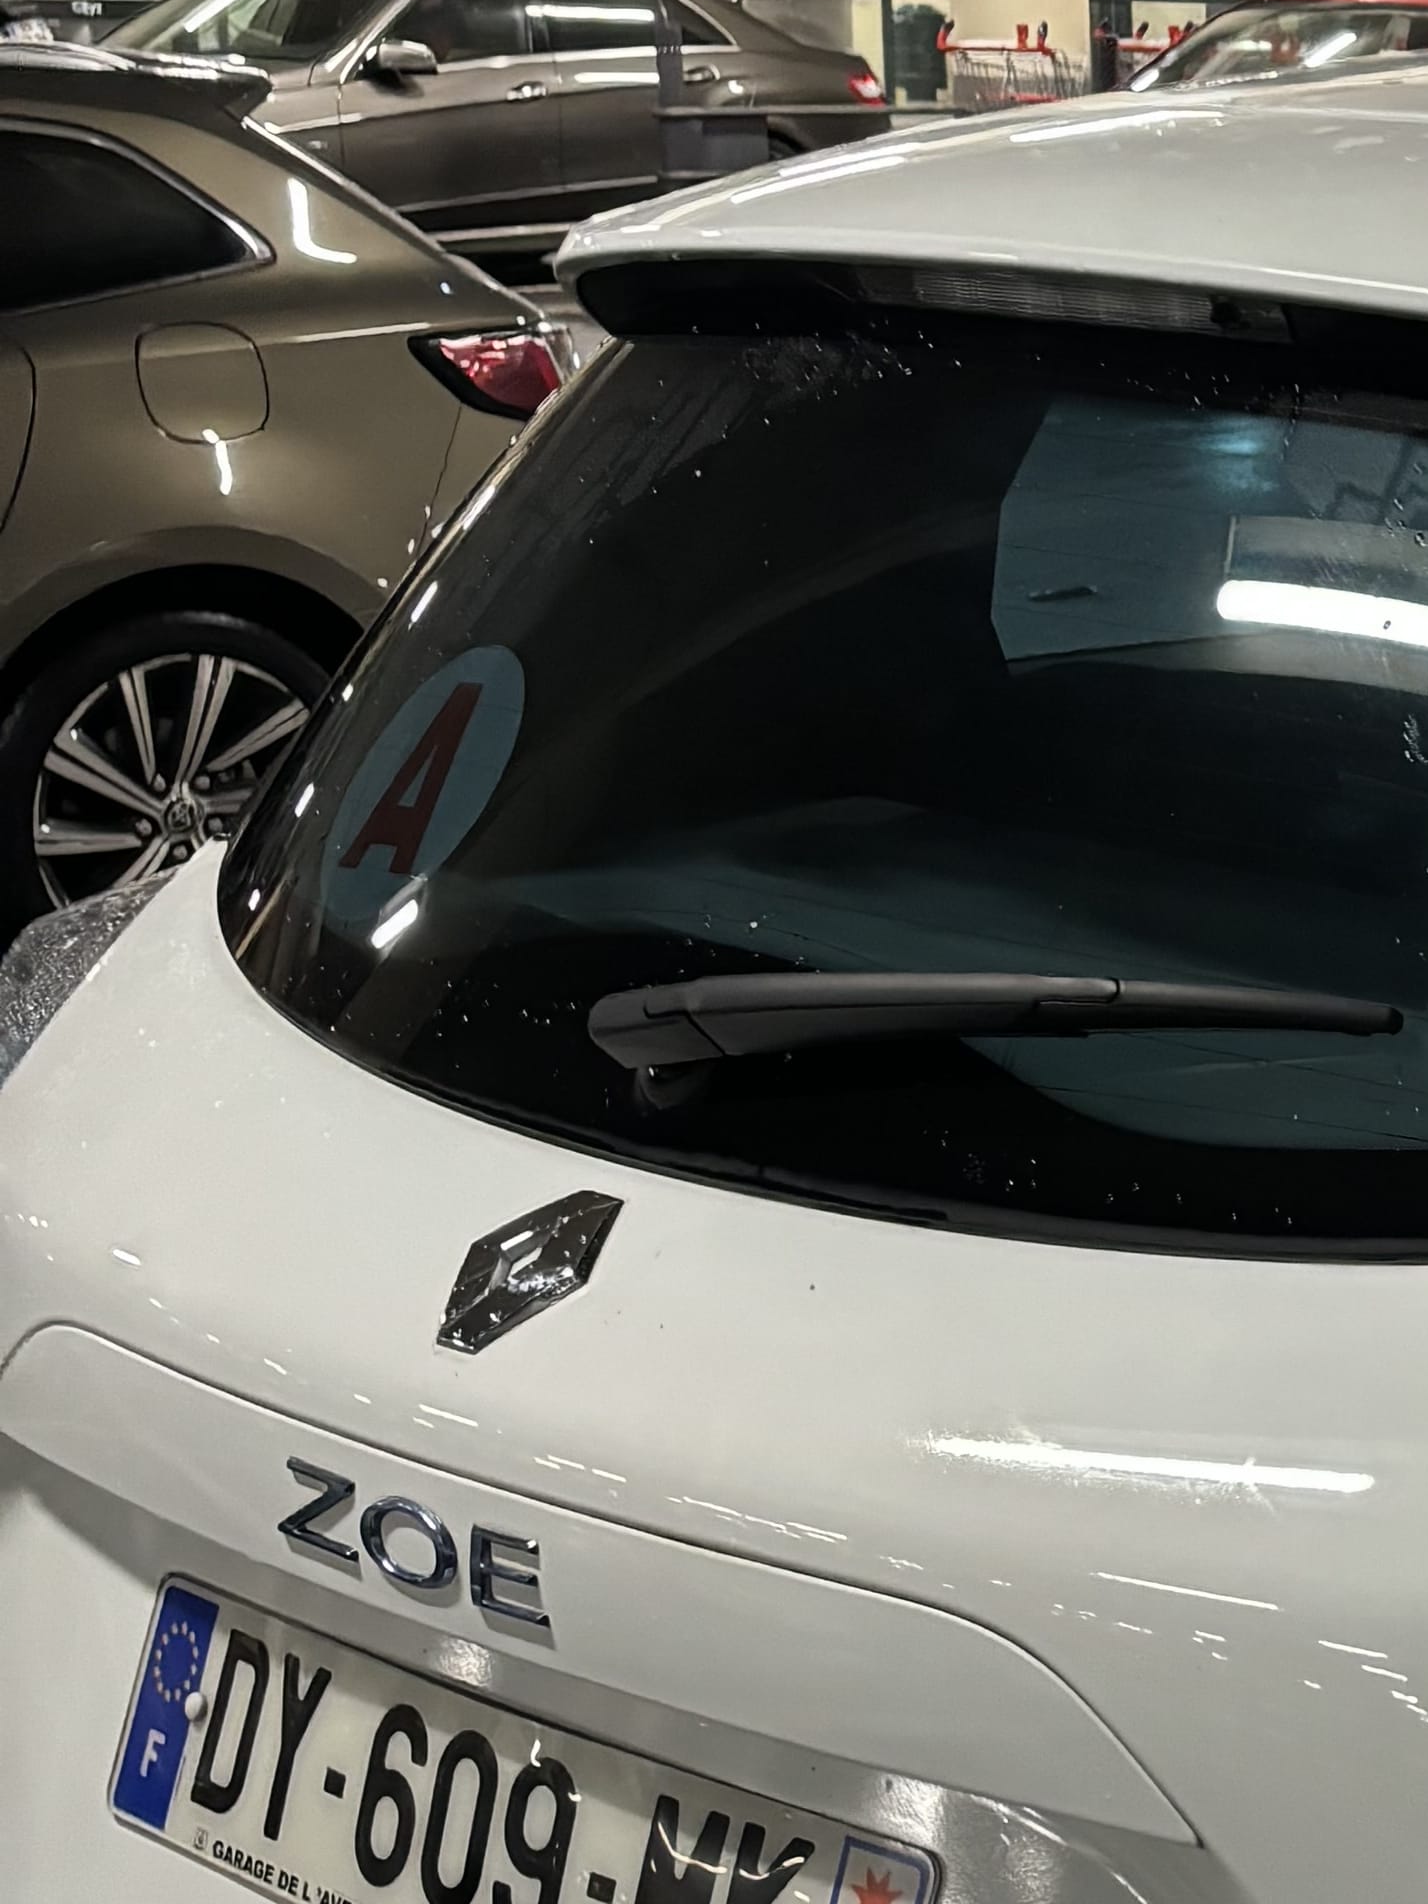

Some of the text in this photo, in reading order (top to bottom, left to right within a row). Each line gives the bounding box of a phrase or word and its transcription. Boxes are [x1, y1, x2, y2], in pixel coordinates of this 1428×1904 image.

[338, 682, 484, 874] A
[278, 1456, 552, 1627] ZOE
[140, 1729, 166, 1777] F
[212, 1840, 275, 1885] GARAGE
[277, 1870, 299, 1895] DE
